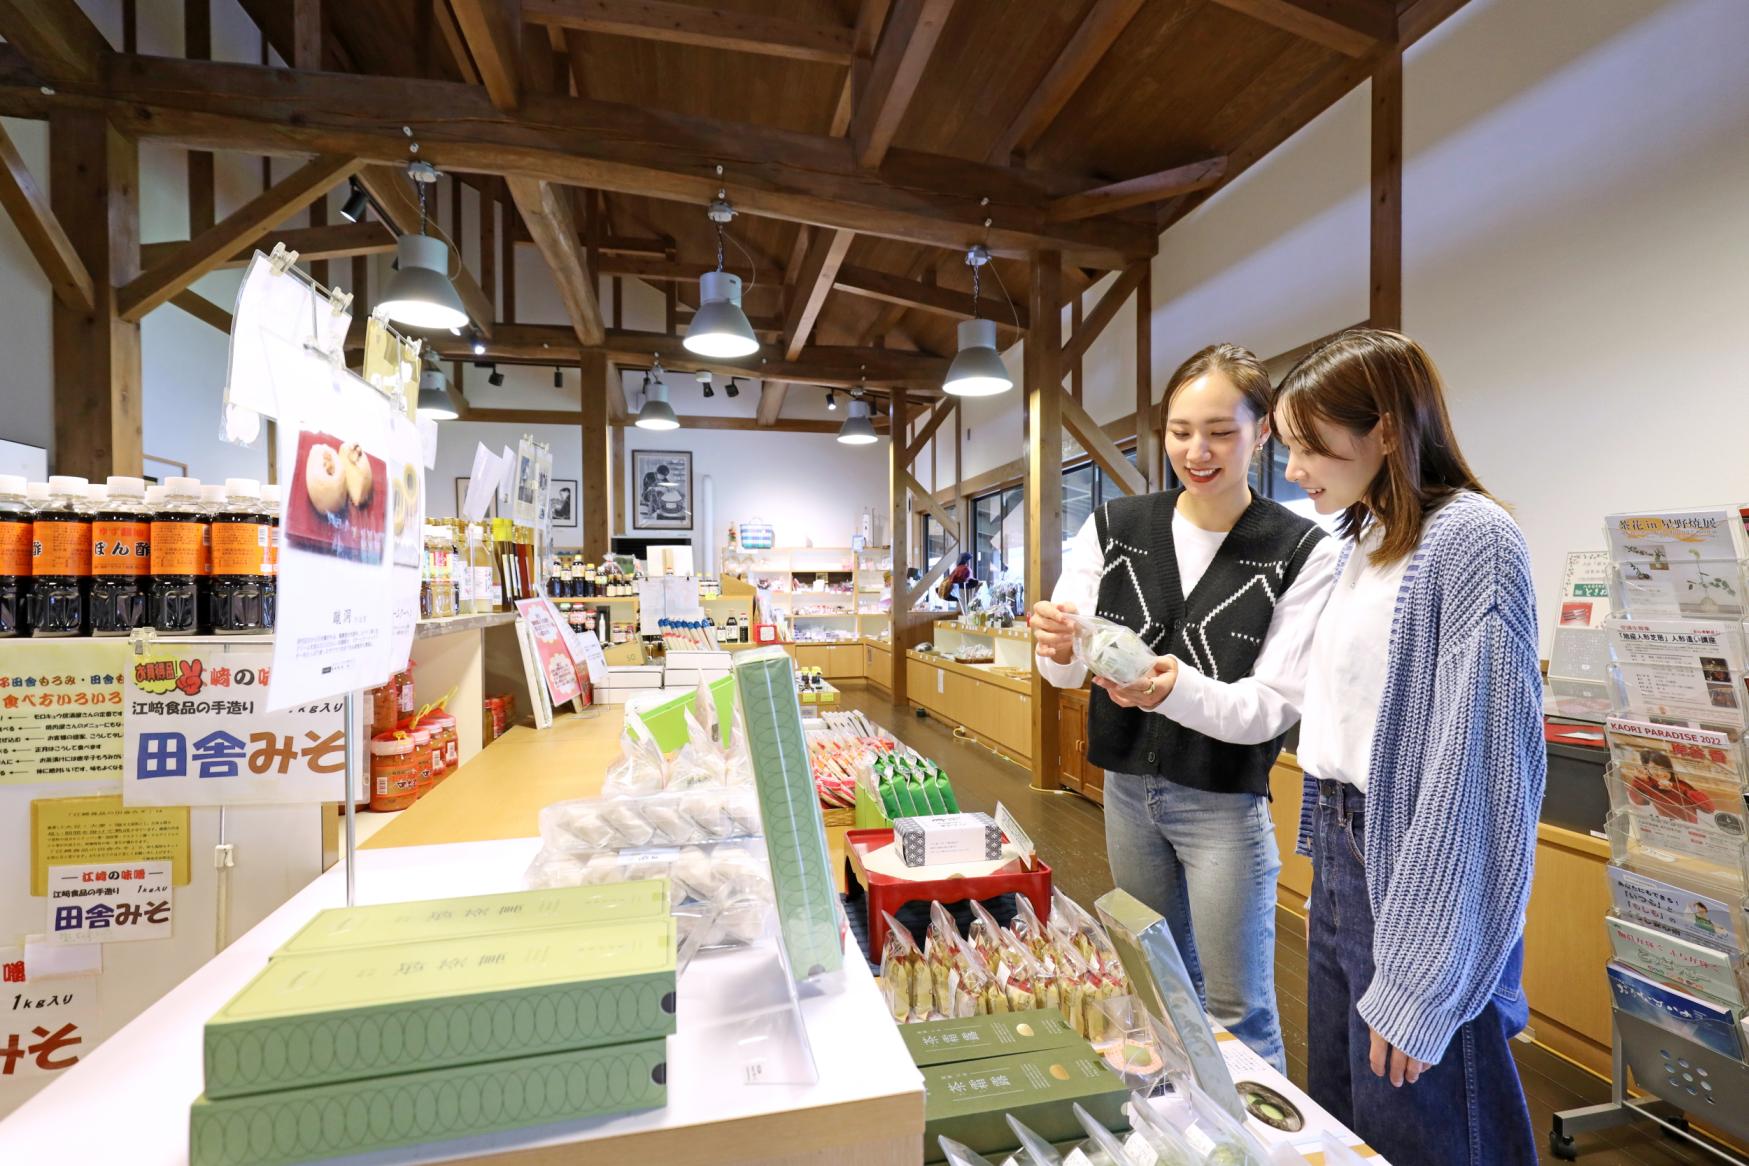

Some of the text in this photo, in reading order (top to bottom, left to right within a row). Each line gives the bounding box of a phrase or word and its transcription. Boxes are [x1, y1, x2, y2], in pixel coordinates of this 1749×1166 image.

[3, 691, 123, 709] 食べ方いろいろ
[1610, 722, 1721, 746] KAORI PARADISE 2022
[136, 729, 346, 780] 田舎みそ
[55, 900, 171, 931] 田舎みそ
[12, 993, 73, 1010] 1kg入り
